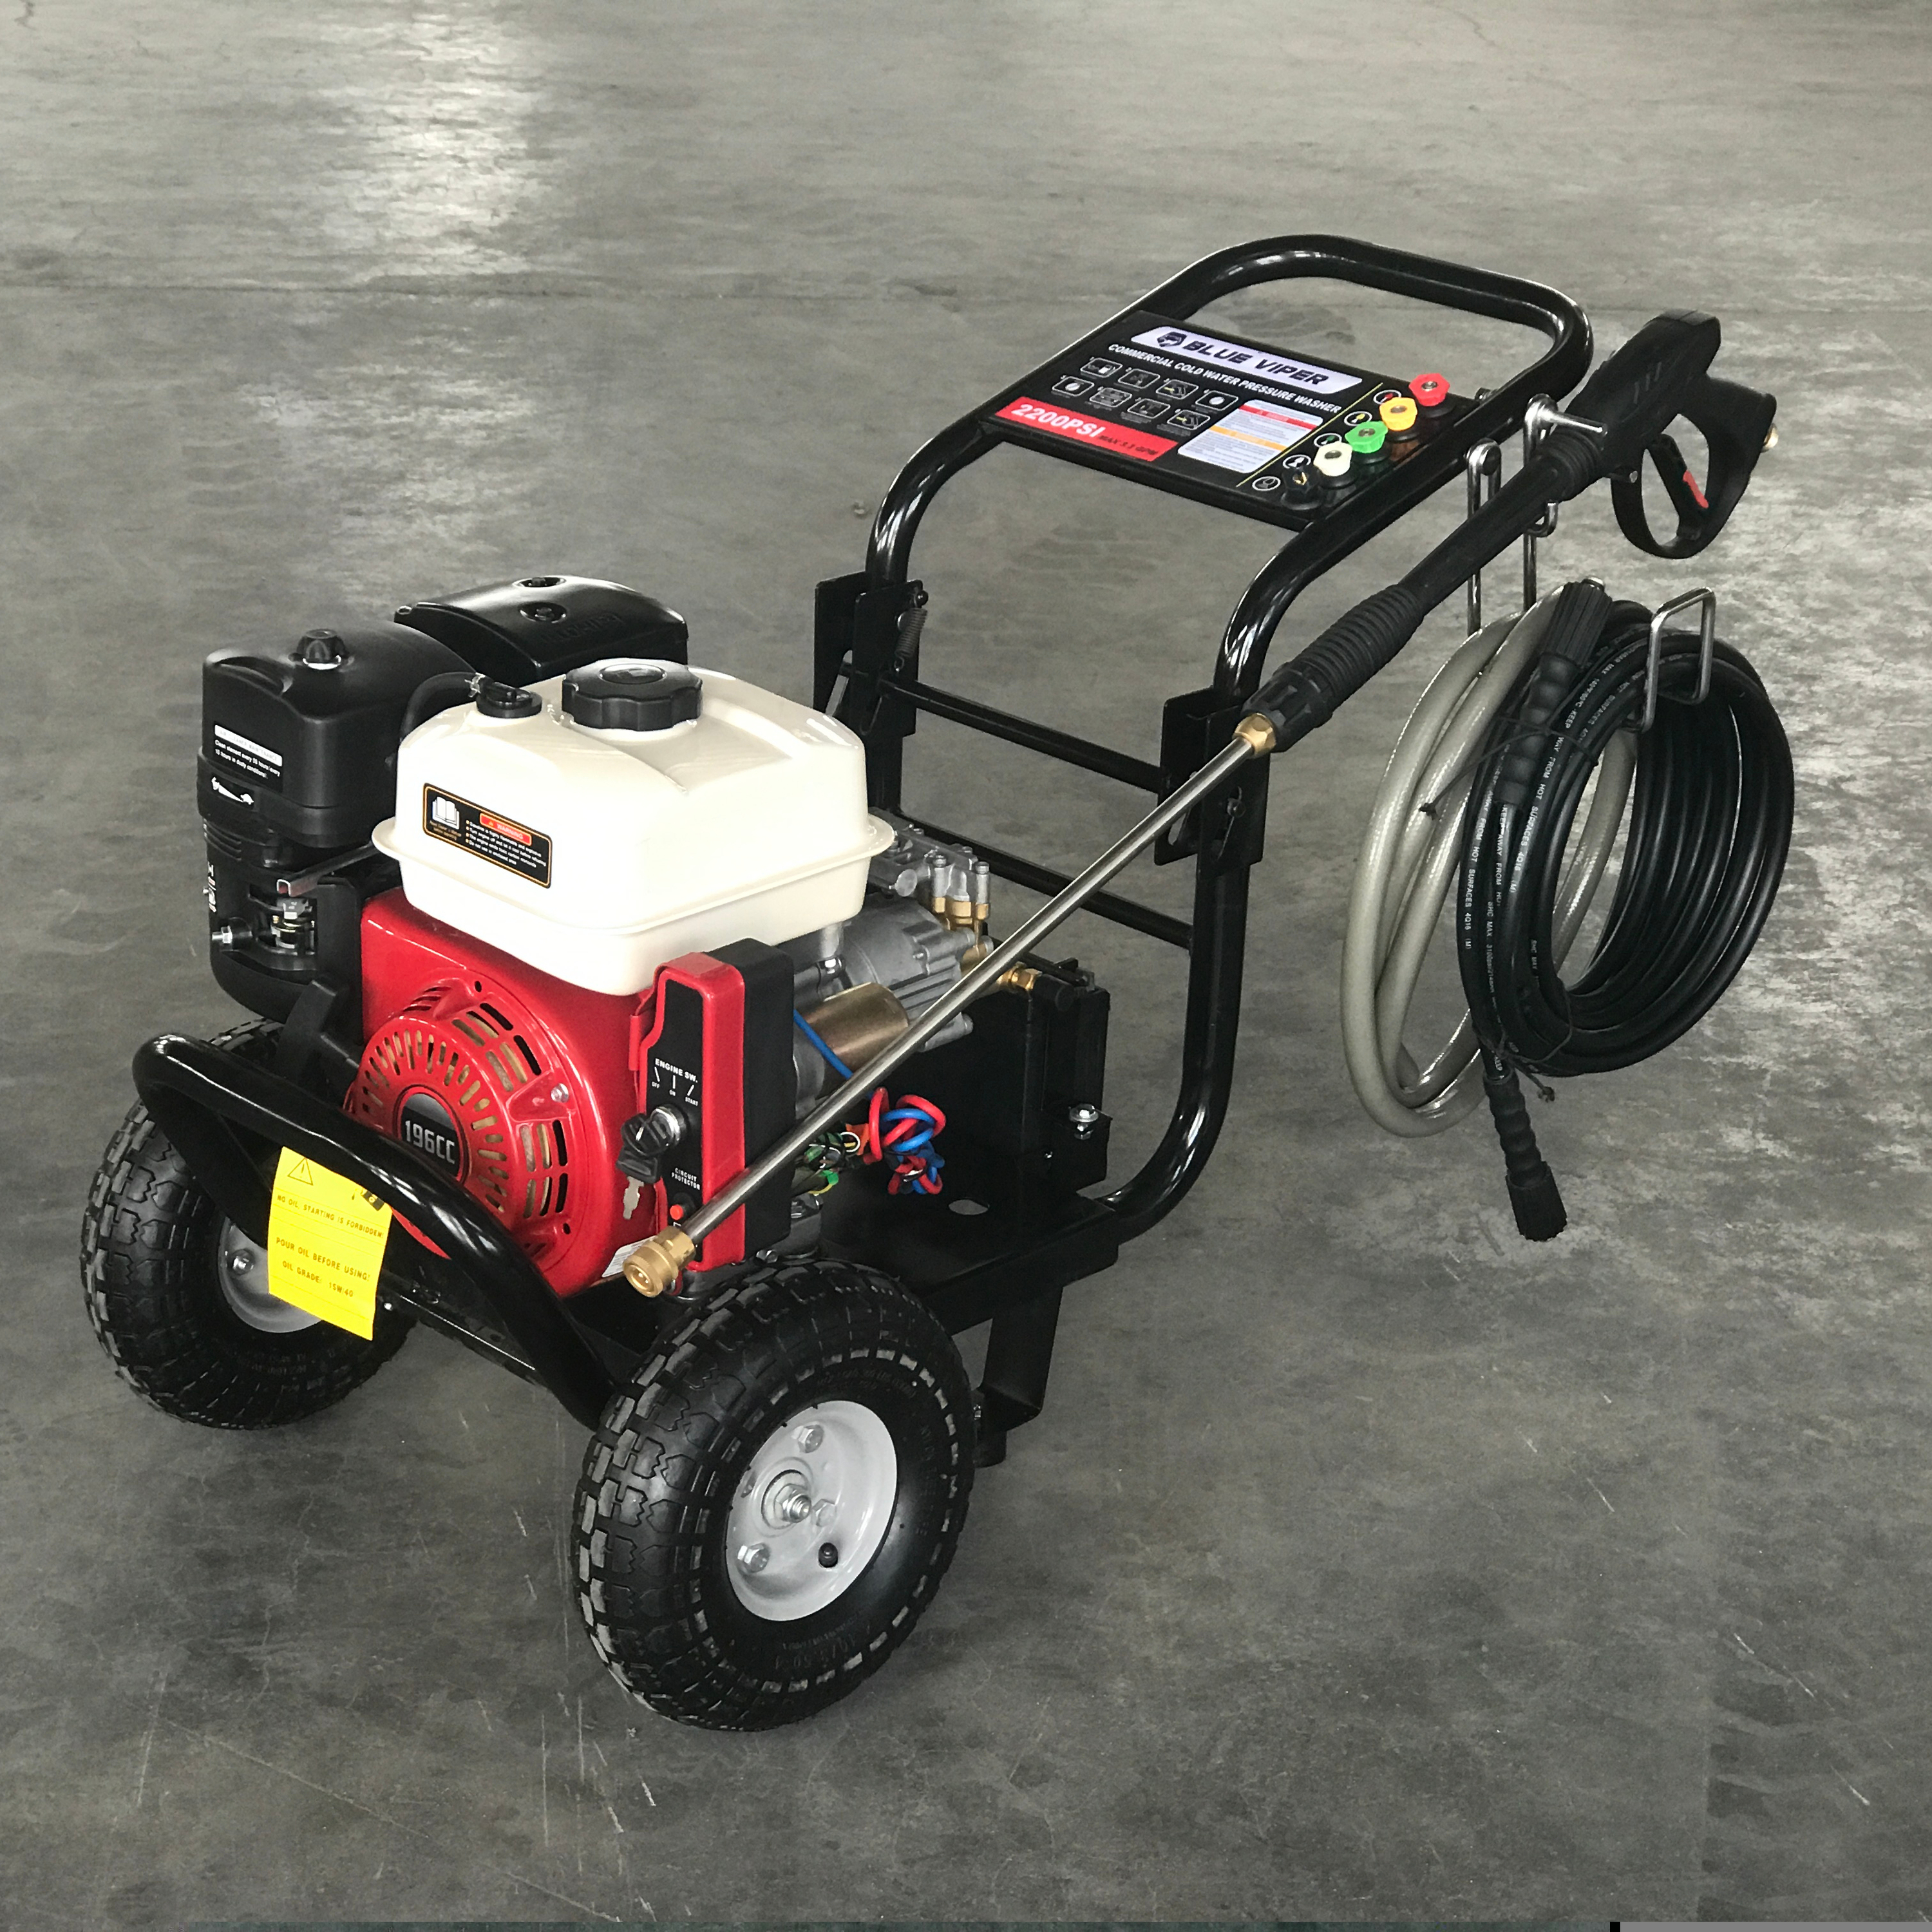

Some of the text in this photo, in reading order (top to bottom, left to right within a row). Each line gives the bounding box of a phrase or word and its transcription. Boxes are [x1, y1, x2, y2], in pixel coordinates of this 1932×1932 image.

[1183, 340, 1329, 385] BLUE VIPER
[1108, 344, 1342, 413] COMMERCIAL COLD WATER PRESSURE WASHER
[1011, 403, 1106, 438] 2200PSI
[1554, 737, 1564, 752] WAY
[1543, 756, 1556, 779] FROM
[1535, 783, 1546, 800] HOT
[497, 822, 524, 840] WARNING
[1520, 806, 1539, 846] SURFACES
[1471, 846, 1481, 862] HOT
[1464, 869, 1476, 907] SURFACES
[655, 1058, 698, 1083] ENGINE SW.
[685, 1096, 699, 1106] START
[405, 1121, 455, 1164] 196CC
[672, 1172, 701, 1190] PROTECTOR
[675, 1168, 697, 1182] CIRCUIT
[303, 1204, 334, 1221] STARTING
[276, 1237, 294, 1251] POUR
[298, 1247, 309, 1258] OIL
[313, 1253, 341, 1270] BEFORE
[282, 1260, 293, 1272] OIL
